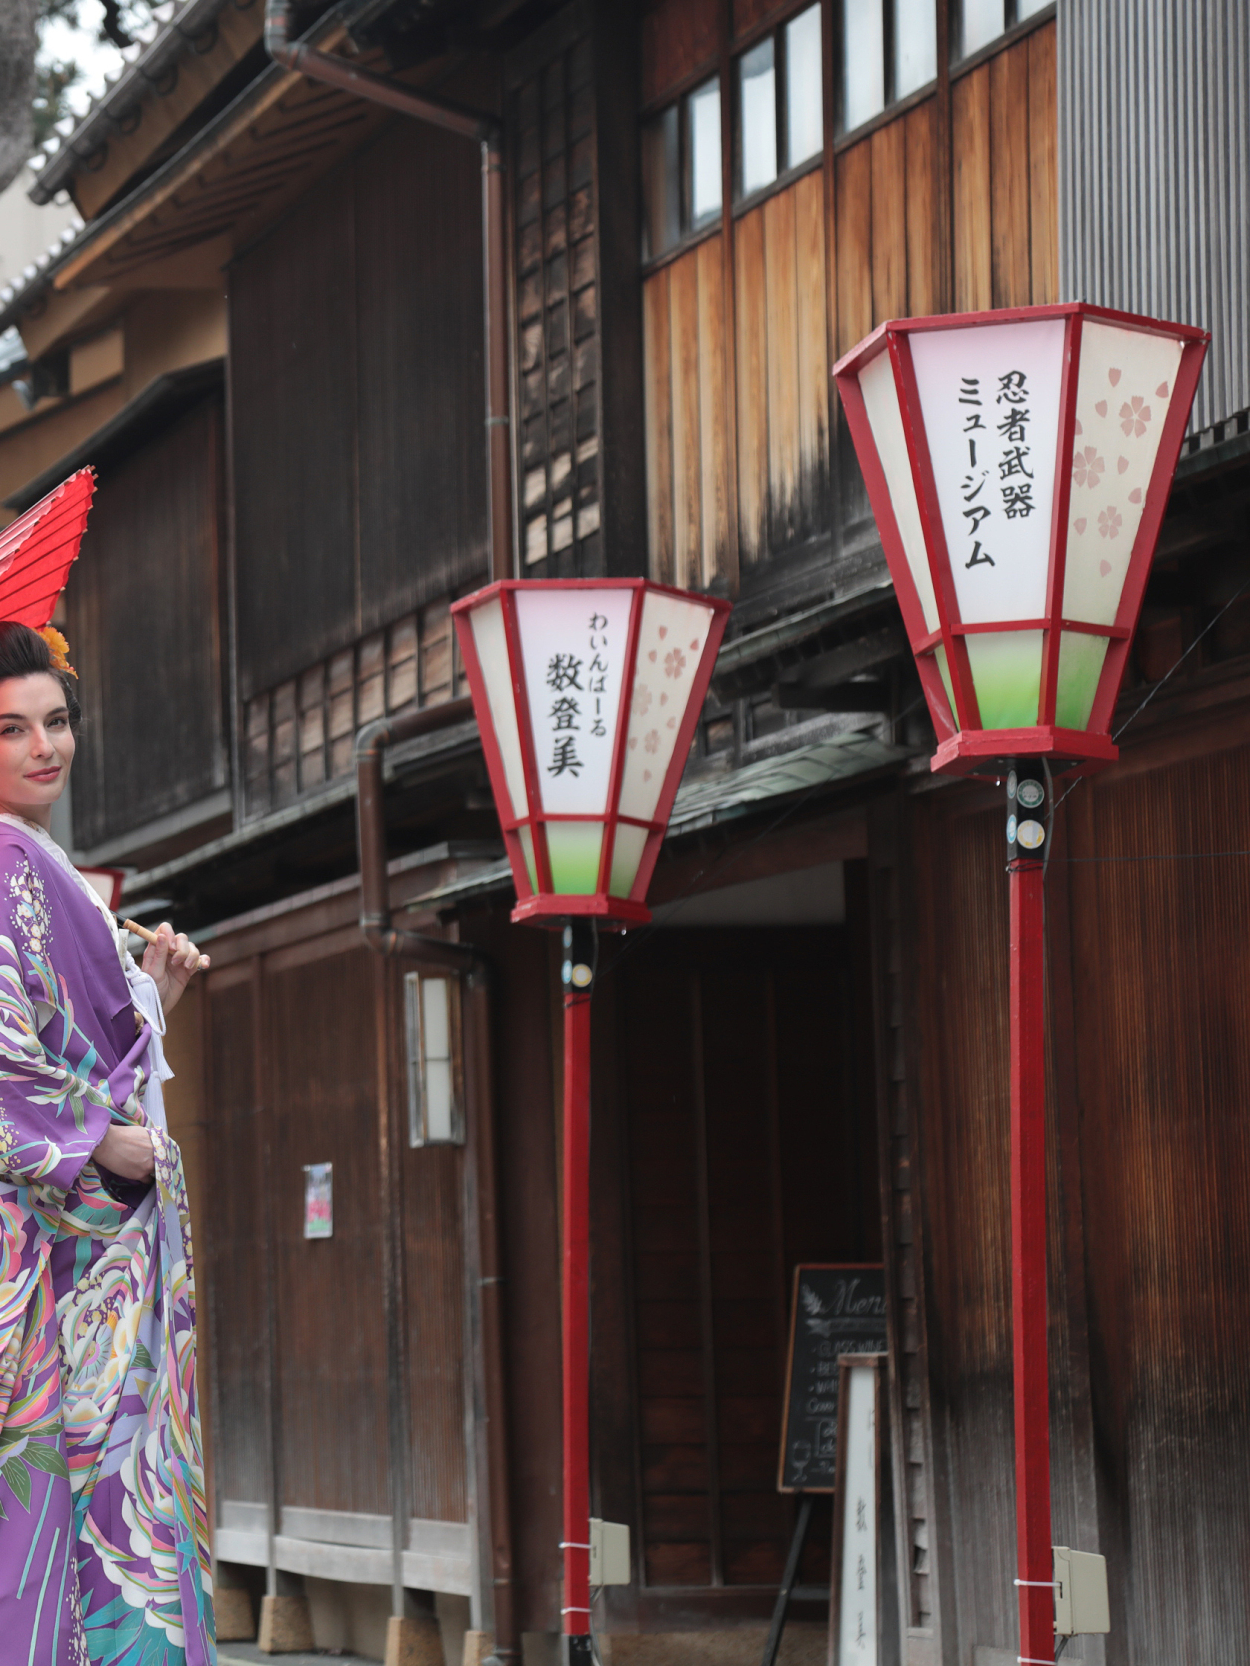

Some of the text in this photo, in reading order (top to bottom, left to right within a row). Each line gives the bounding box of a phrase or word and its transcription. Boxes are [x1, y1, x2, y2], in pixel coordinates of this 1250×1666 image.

[958, 376, 995, 570] ミュージアム
[996, 370, 1036, 519] 忍者武器
[546, 653, 584, 778] 数登美
[588, 612, 609, 737] わいんばーる
